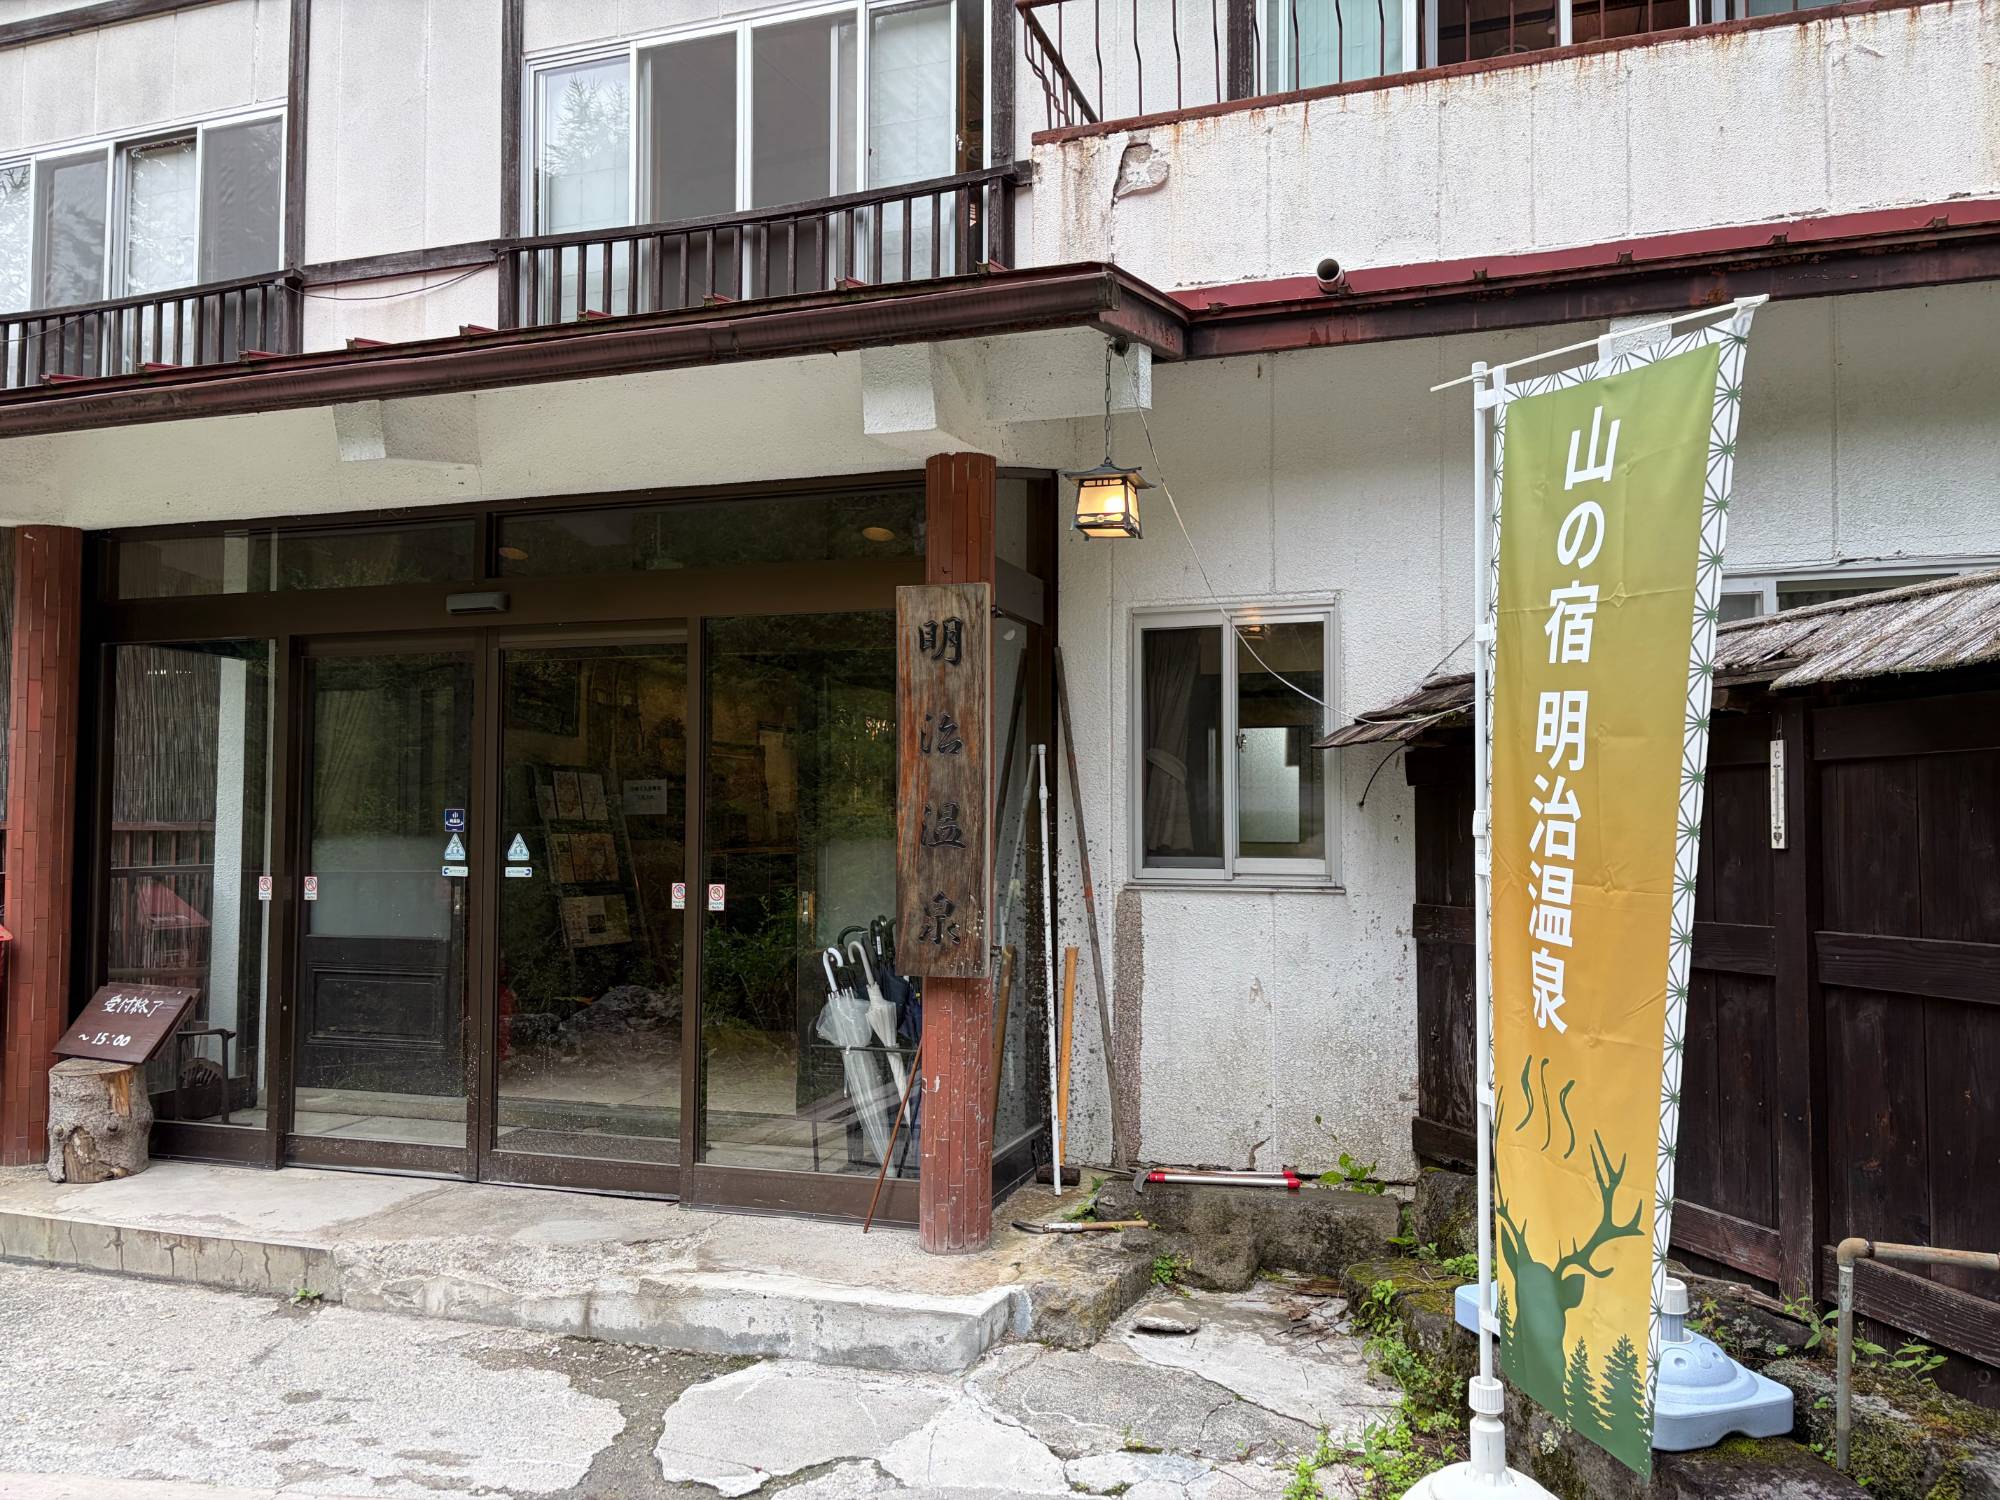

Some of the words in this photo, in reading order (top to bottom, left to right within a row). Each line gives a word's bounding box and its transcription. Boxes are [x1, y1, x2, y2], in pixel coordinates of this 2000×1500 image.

[1544, 405, 1621, 664] 山の宿
[918, 616, 968, 945] 明治温泉
[1527, 690, 1589, 1035] 明治温泉
[101, 994, 164, 1017] 受付終了
